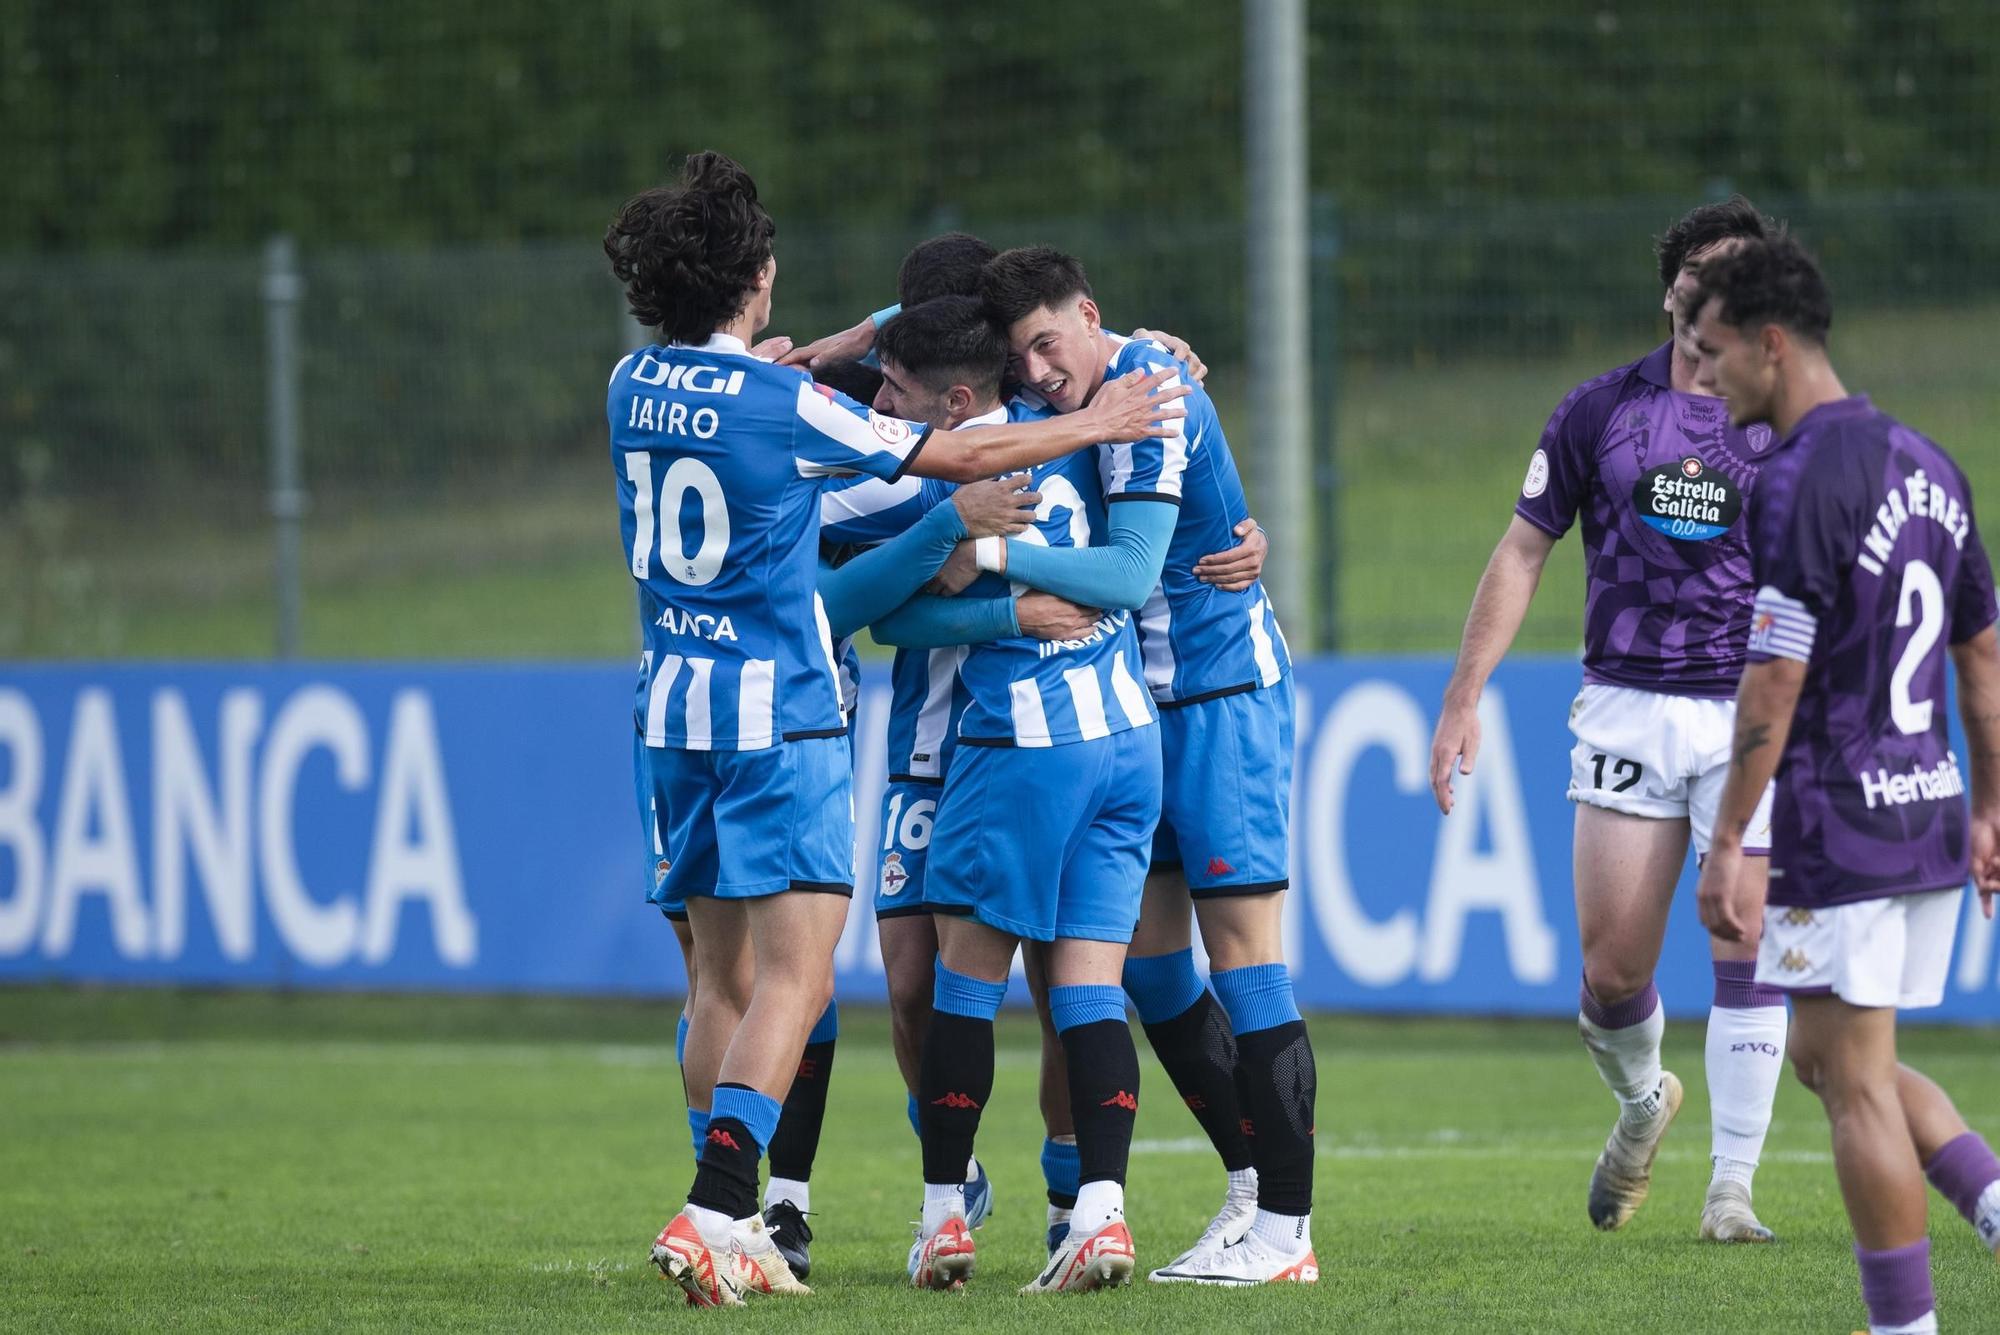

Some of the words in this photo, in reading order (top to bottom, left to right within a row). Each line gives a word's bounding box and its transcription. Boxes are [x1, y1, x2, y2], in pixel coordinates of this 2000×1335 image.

[631, 355, 745, 395] DIGI
[629, 396, 719, 439] JAIRO
[1651, 473, 1726, 503] Estrella
[1652, 494, 1719, 522] Galicia
[625, 451, 730, 586] 10
[655, 608, 738, 641] ANCA
[1890, 559, 1944, 735] 2
[1590, 754, 1642, 793] 12
[884, 792, 937, 850] 16
